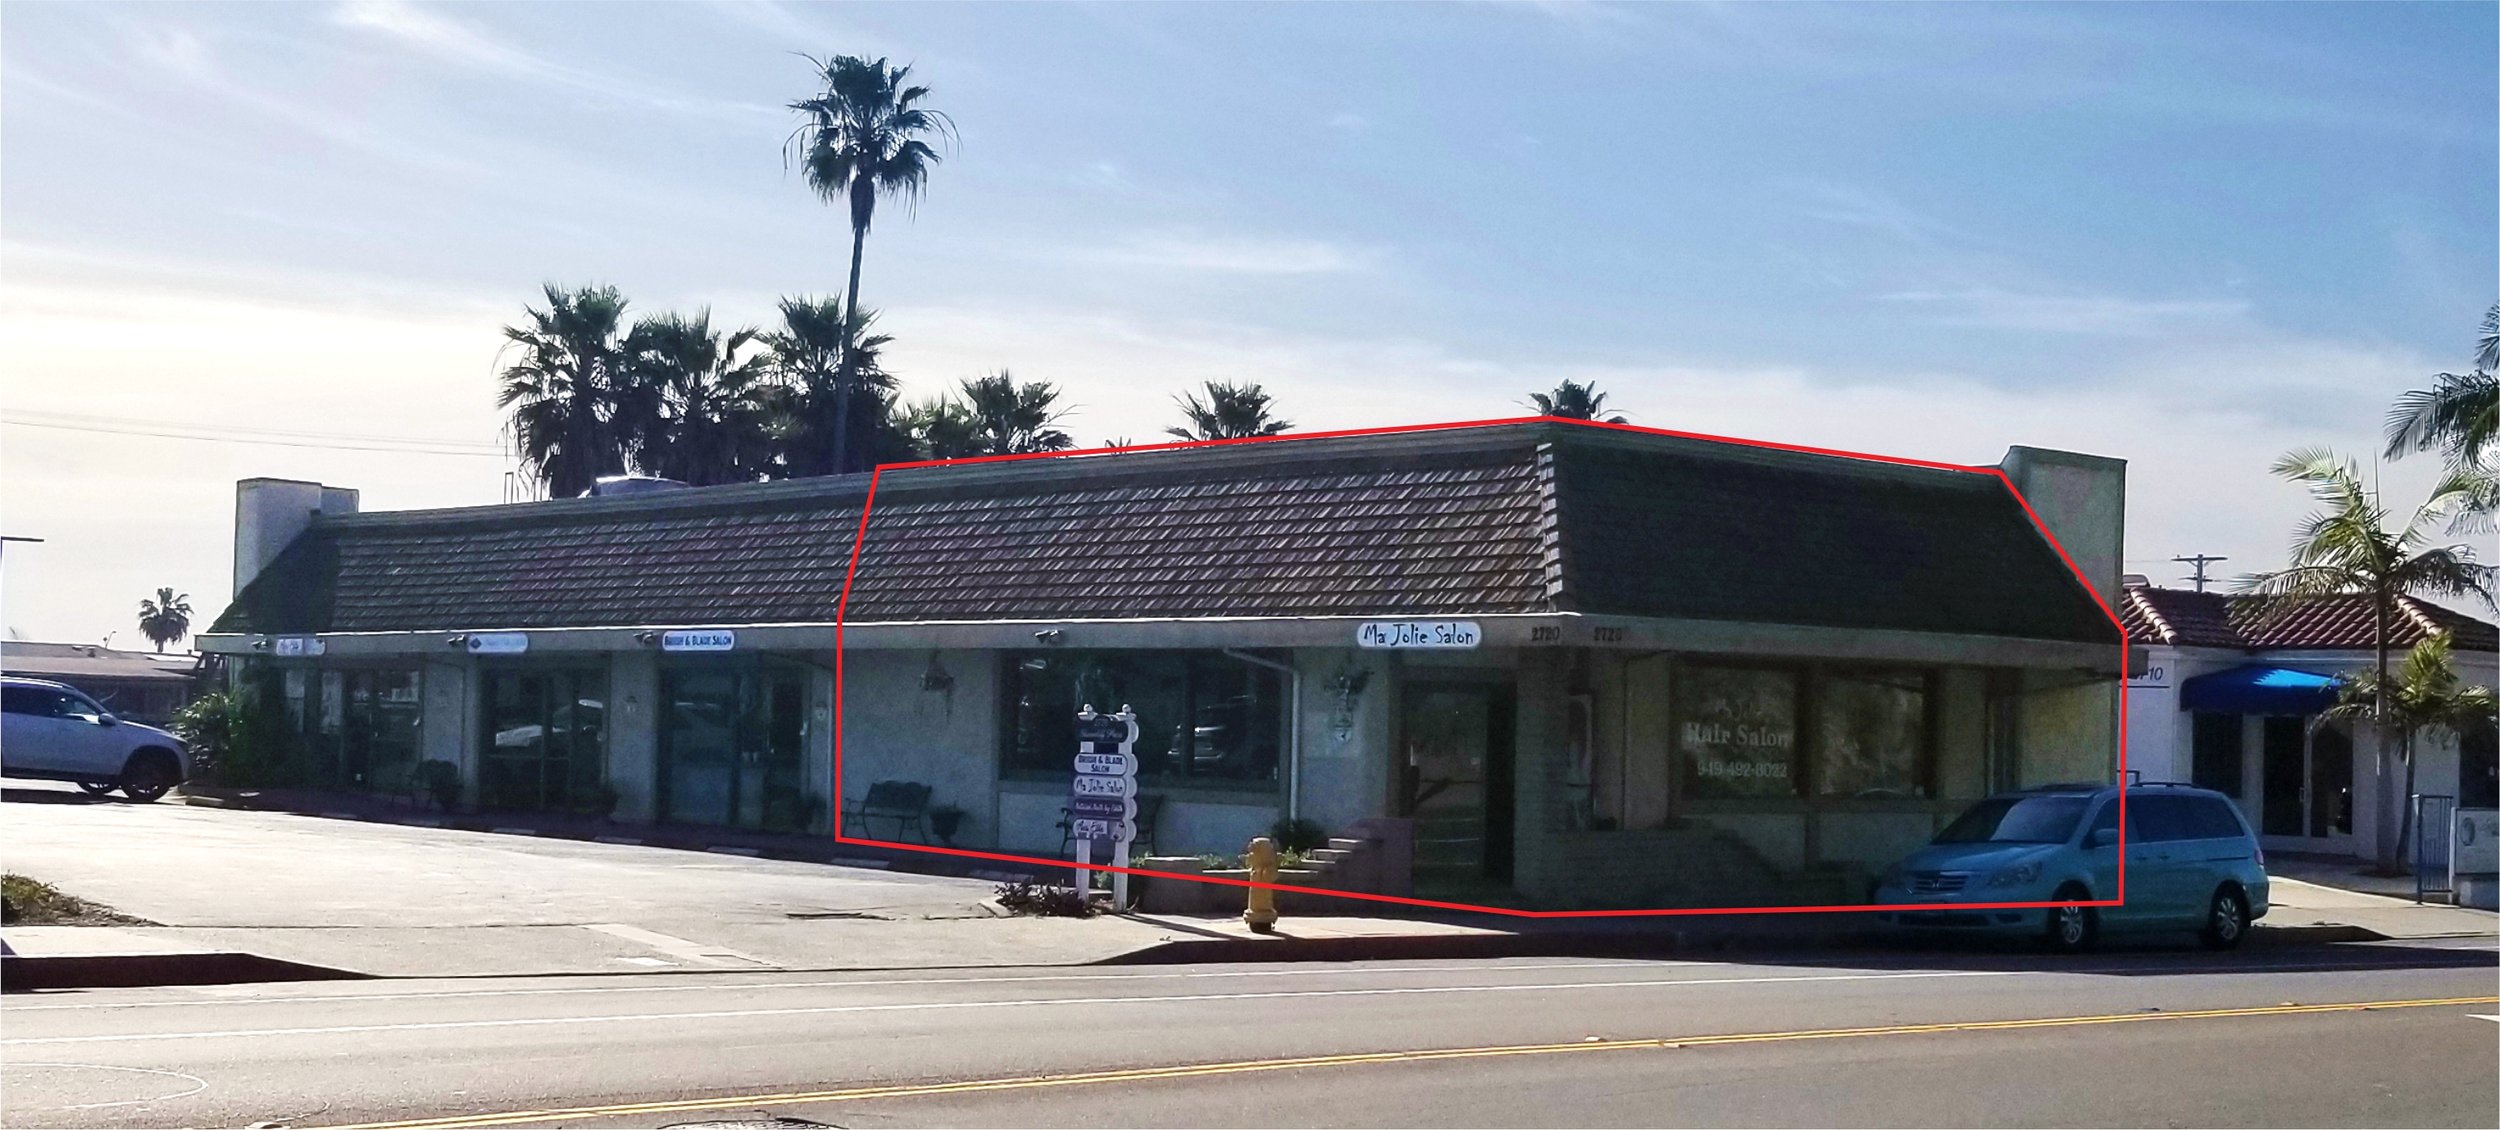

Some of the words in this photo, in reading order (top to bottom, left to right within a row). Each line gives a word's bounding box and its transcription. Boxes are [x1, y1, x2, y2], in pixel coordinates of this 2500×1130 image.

[1363, 623, 1386, 645] Ma
[1389, 623, 1428, 646] Jolie
[1435, 622, 1474, 645] Salon
[1531, 626, 1560, 641] 2720
[1736, 724, 1791, 747] Salon
